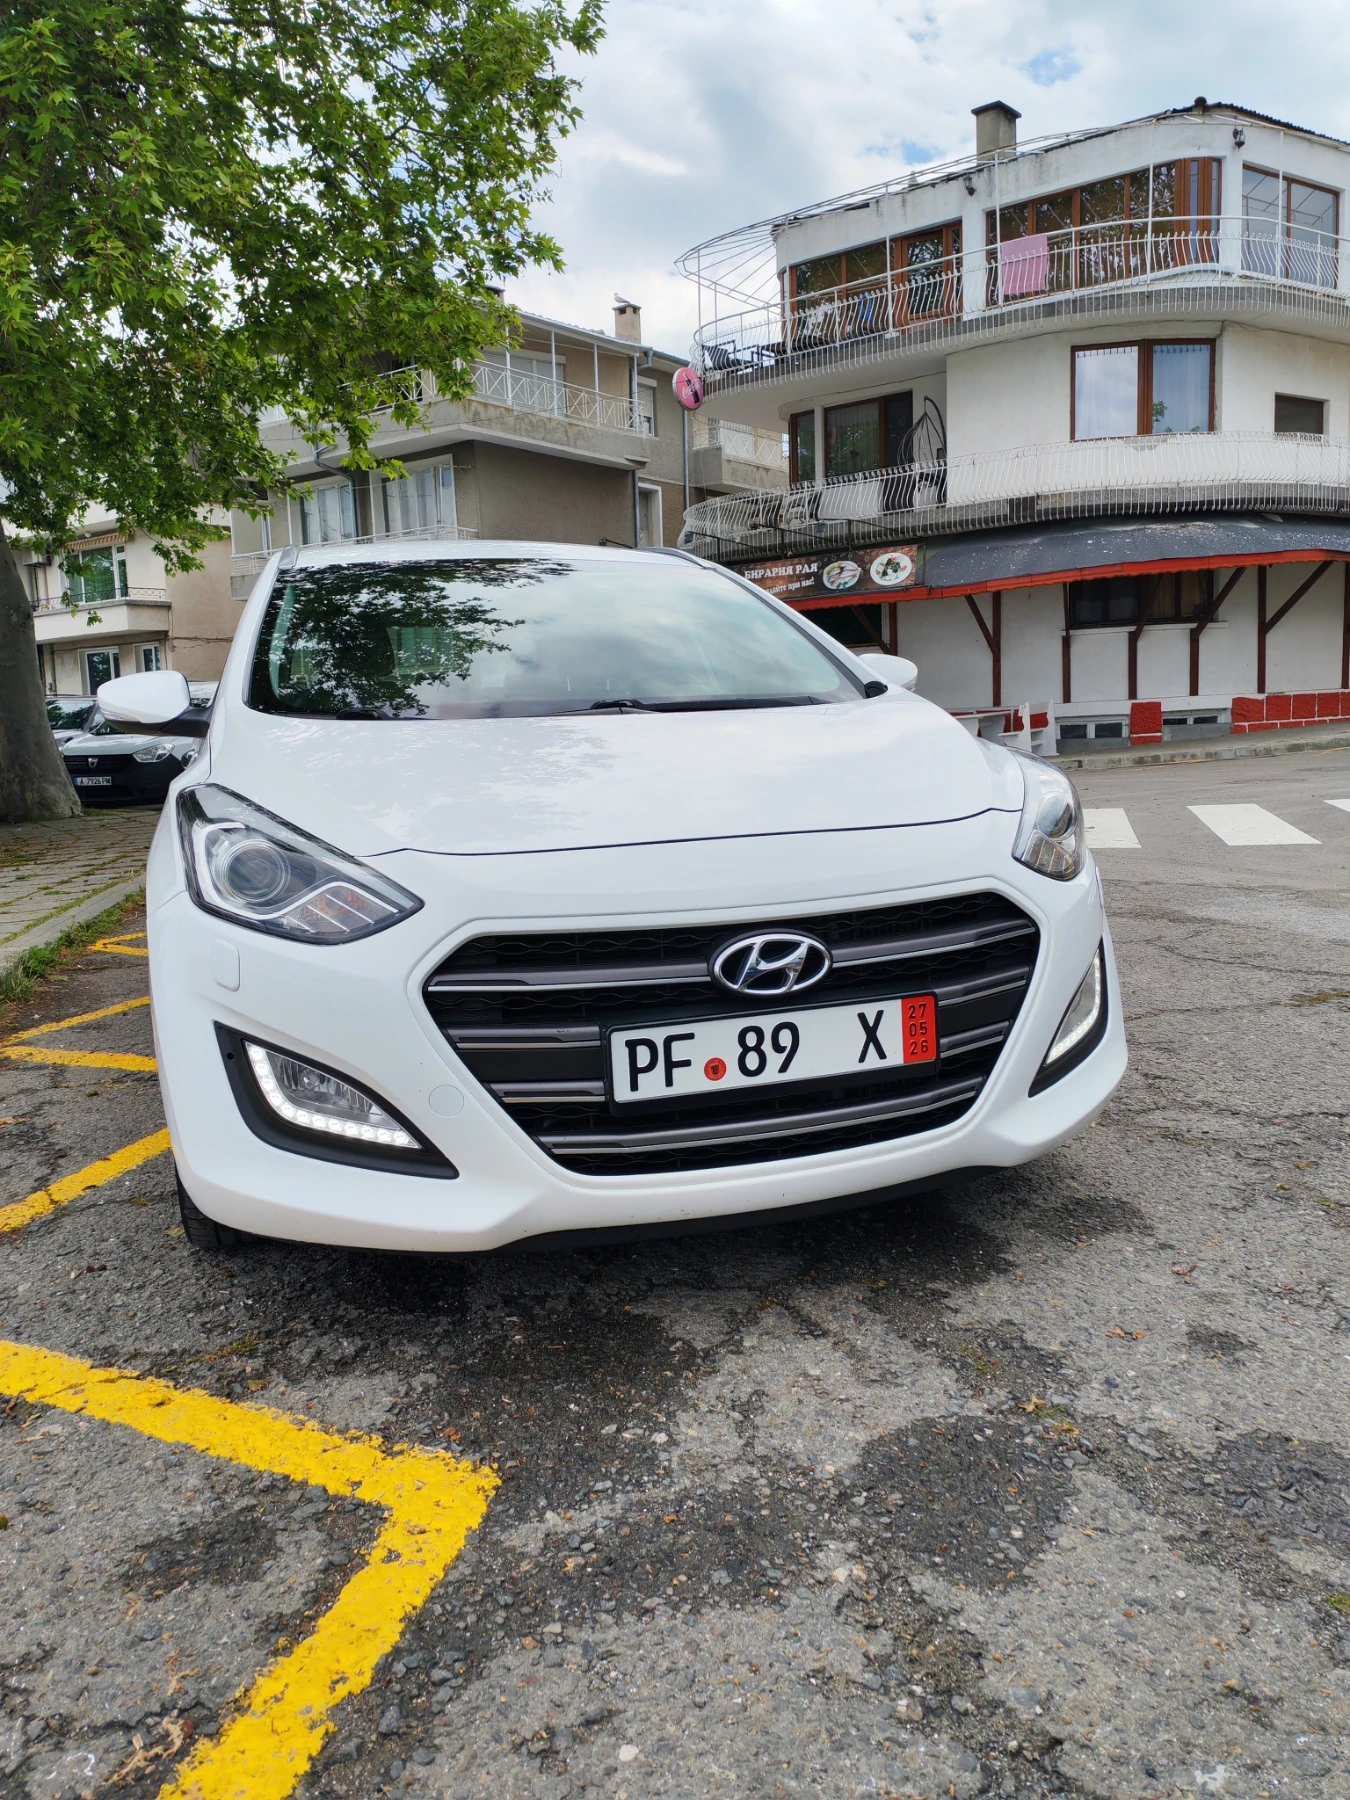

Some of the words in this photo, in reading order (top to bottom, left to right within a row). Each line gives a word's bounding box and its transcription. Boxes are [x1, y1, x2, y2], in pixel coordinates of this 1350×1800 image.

[744, 565, 793, 579] БИРАРИЯ
[796, 562, 818, 574] РАЯ
[907, 1003, 927, 1019] 27
[909, 1021, 928, 1037] 05
[624, 1032, 695, 1092] PF
[737, 1021, 800, 1078] 89
[857, 1009, 887, 1063] X
[910, 1040, 929, 1056] 26
